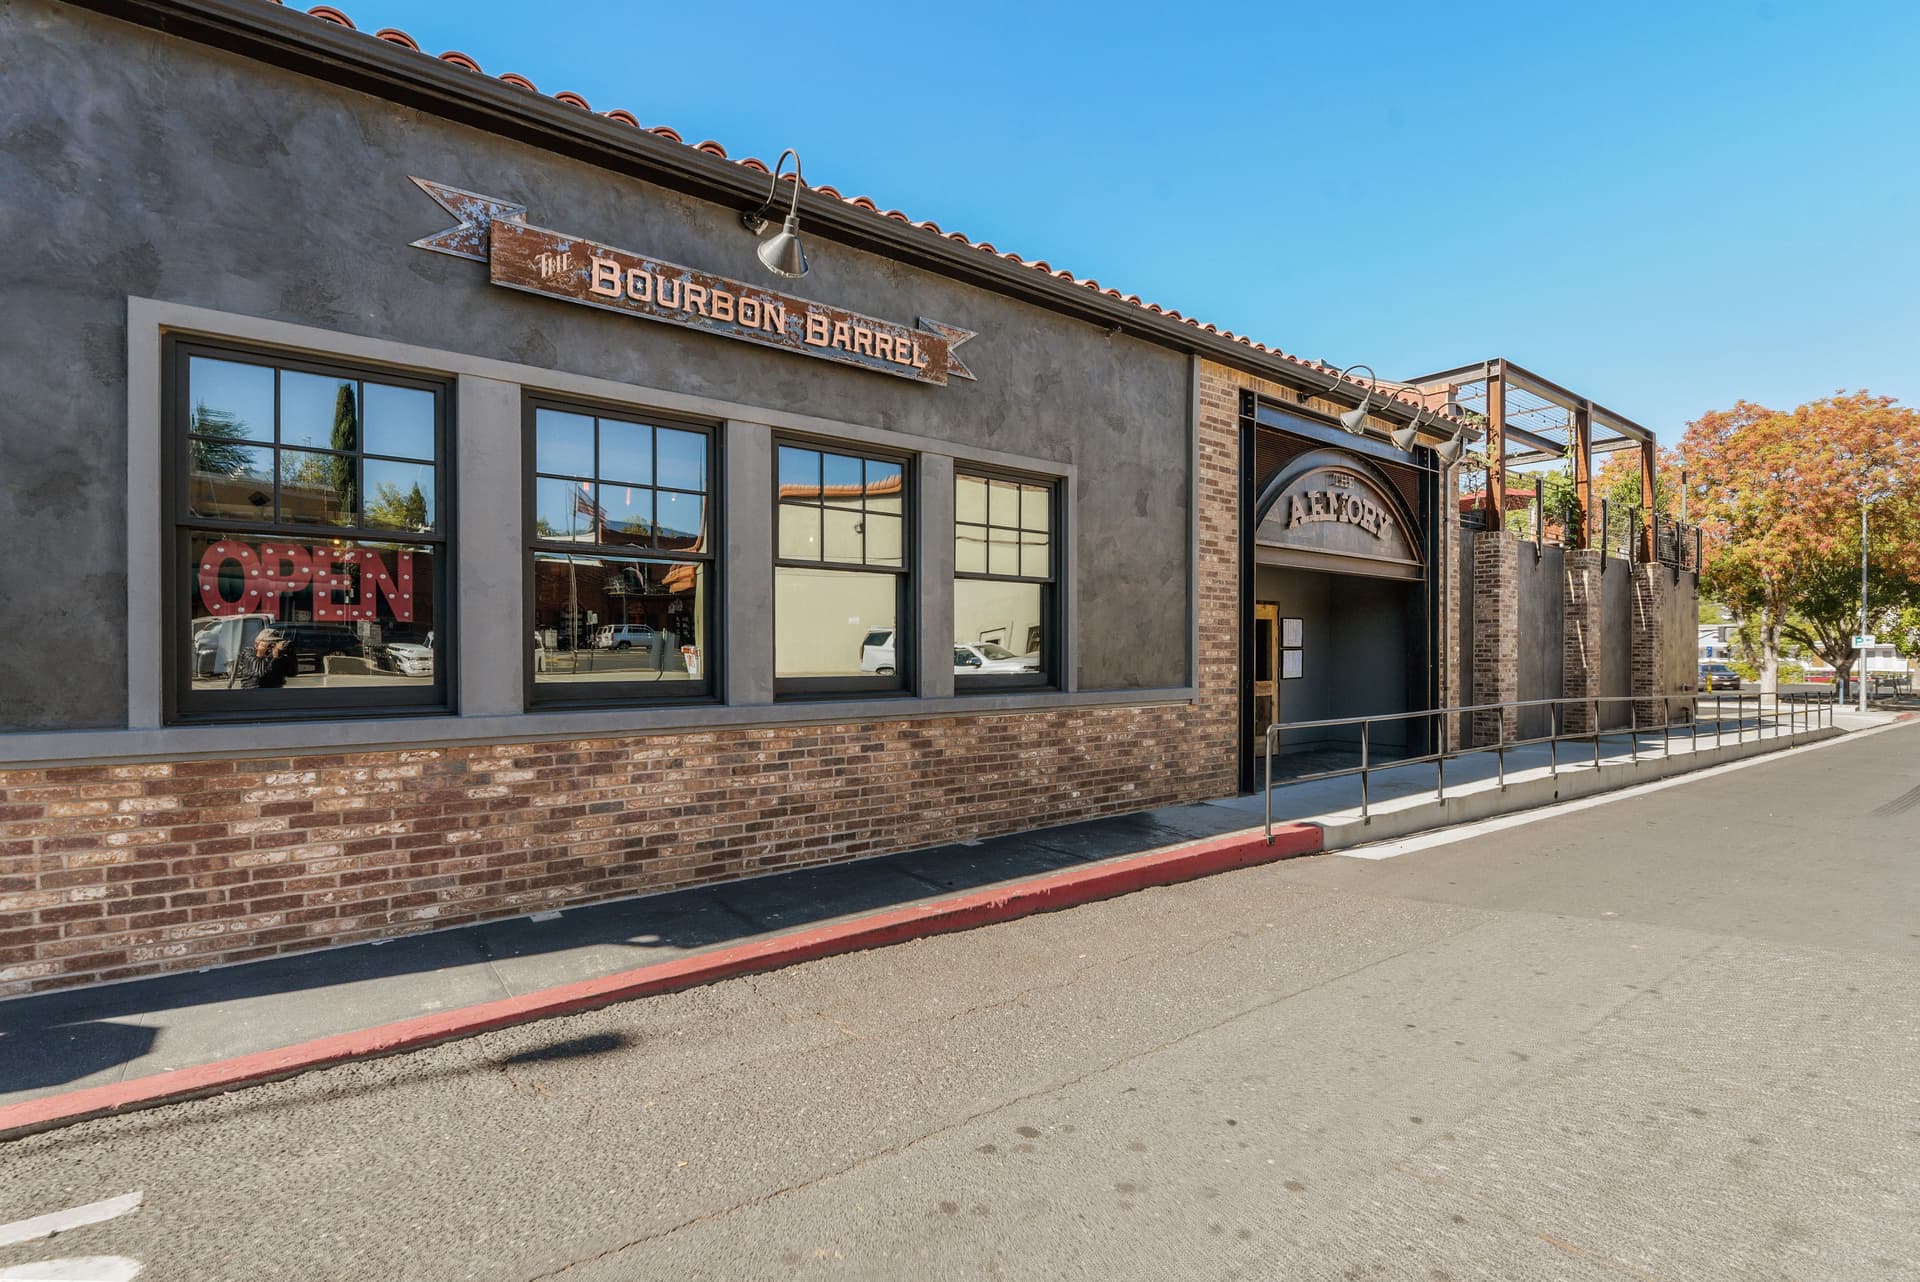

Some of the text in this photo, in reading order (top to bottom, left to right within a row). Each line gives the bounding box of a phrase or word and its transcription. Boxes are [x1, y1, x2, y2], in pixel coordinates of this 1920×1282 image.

[534, 251, 575, 279] THE
[1333, 472, 1355, 489] THE
[1289, 490, 1394, 541] ARMORY
[200, 540, 414, 623] OPEN
